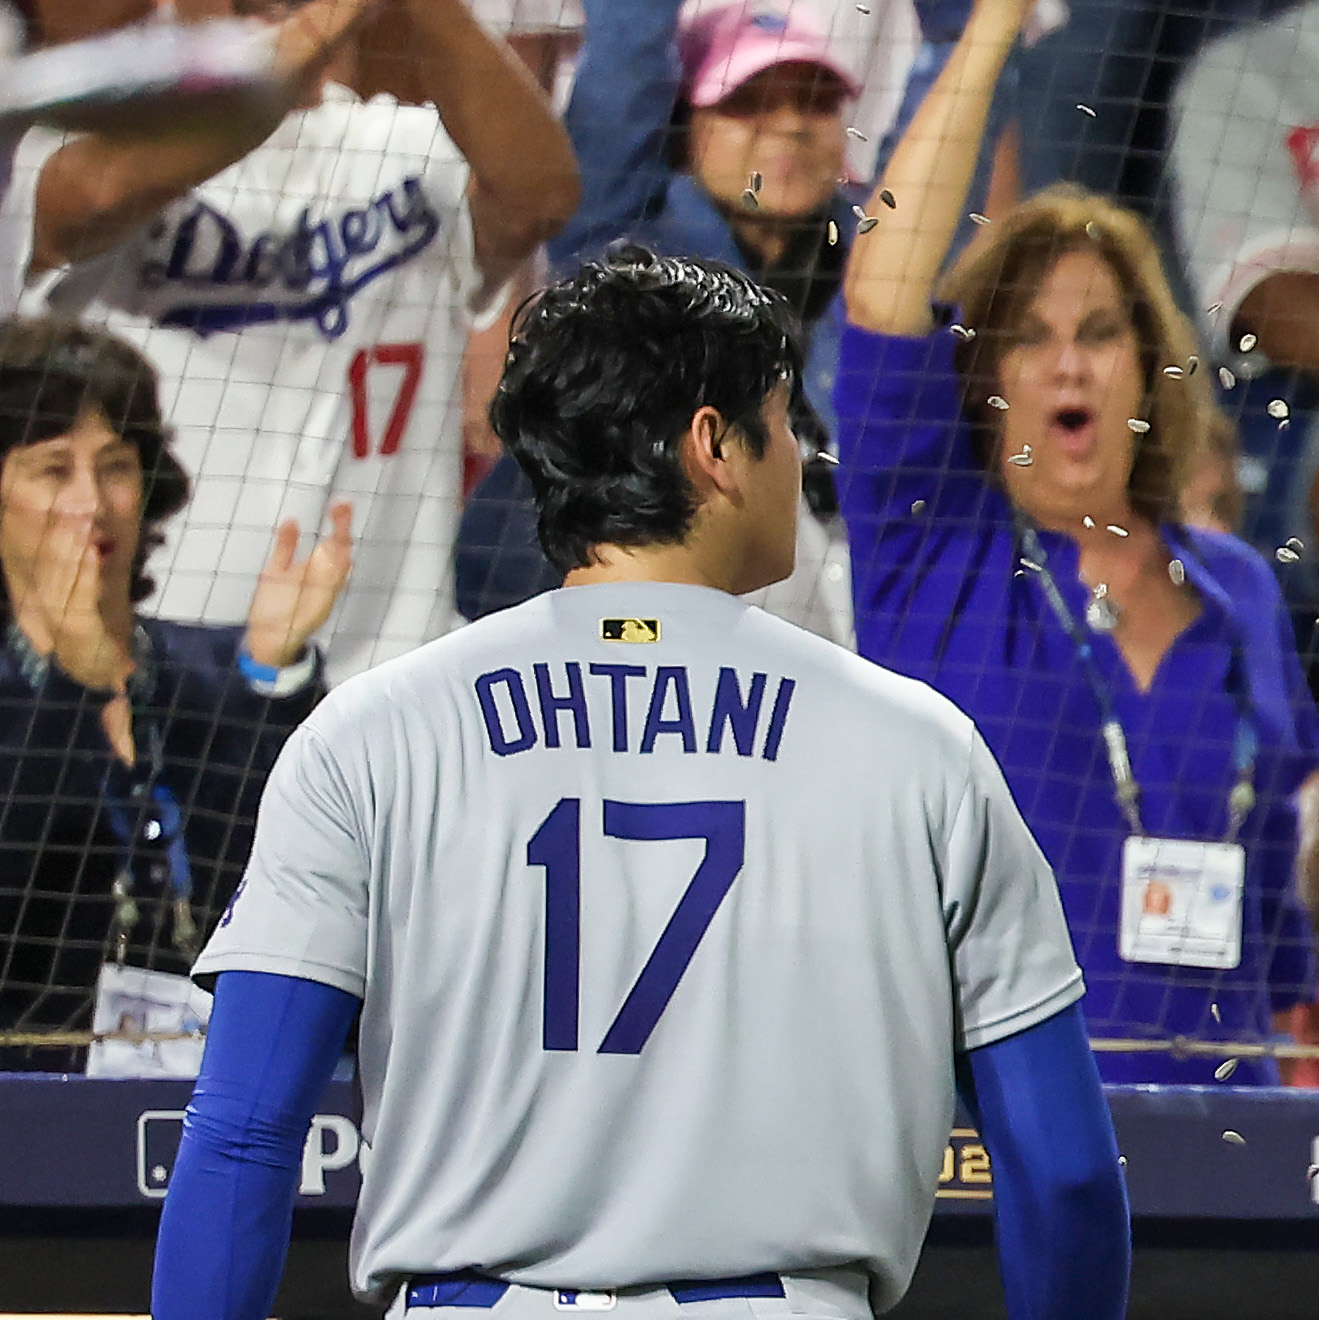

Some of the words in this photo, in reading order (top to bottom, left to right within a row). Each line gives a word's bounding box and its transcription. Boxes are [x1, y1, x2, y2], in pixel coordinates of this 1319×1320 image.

[348, 342, 425, 459] 17
[475, 662, 796, 762] OHTANI
[527, 797, 746, 1056] 17
